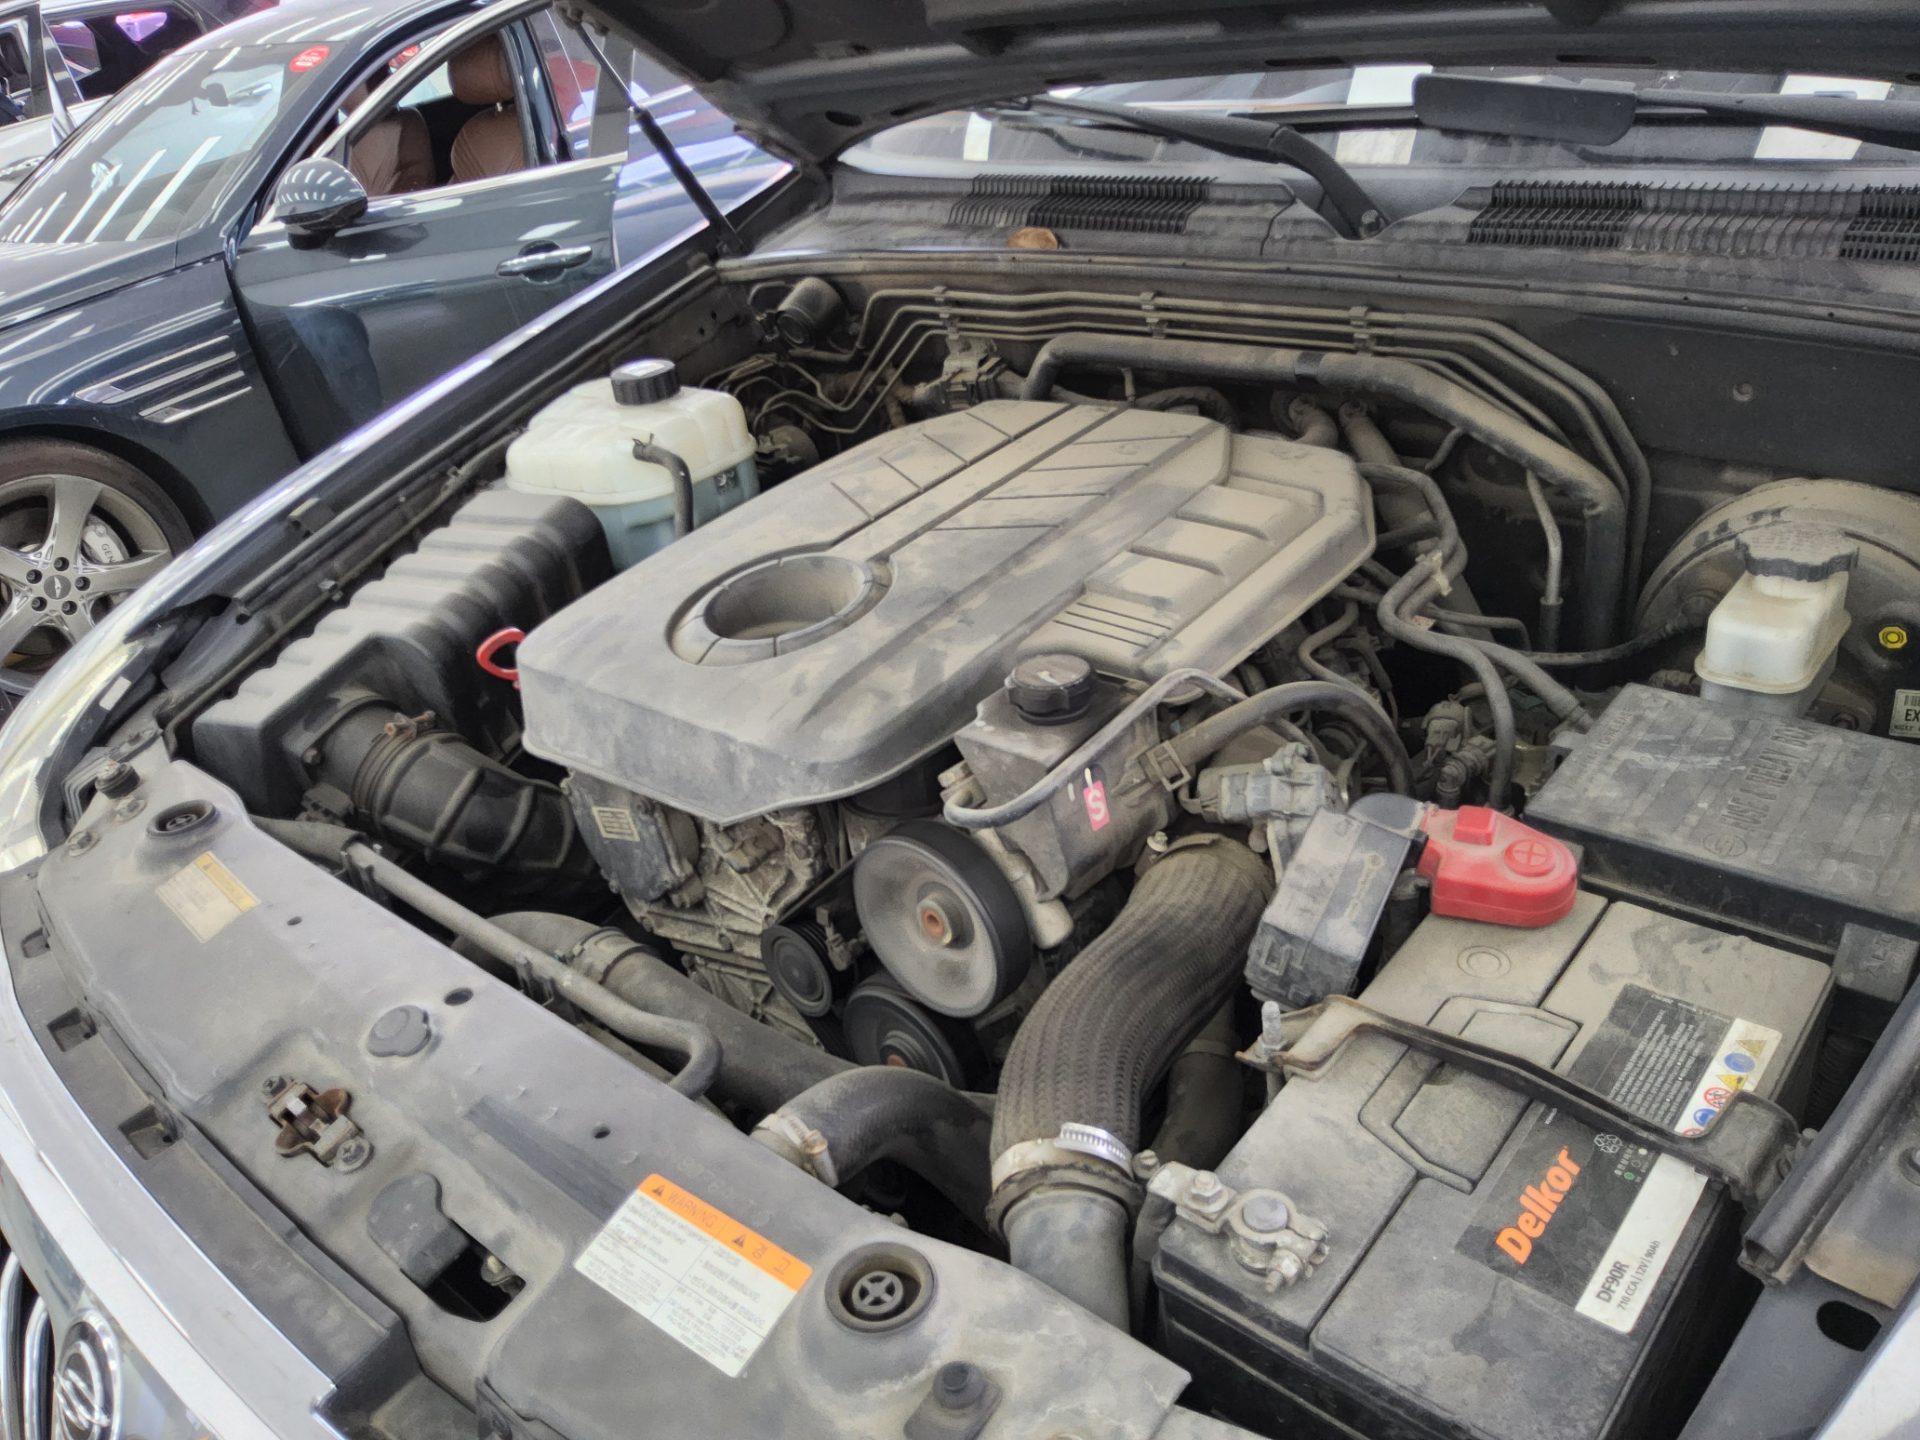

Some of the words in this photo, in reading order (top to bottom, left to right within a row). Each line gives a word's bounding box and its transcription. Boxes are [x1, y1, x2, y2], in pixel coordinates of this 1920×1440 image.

[666, 1191, 719, 1229] WARNING
[1495, 1147, 1580, 1265] Delkor
[1596, 1260, 1629, 1303] DF90R
[1617, 1295, 1630, 1311] 710
[1625, 1280, 1639, 1297] CCA
[1636, 1261, 1648, 1277] 12V
